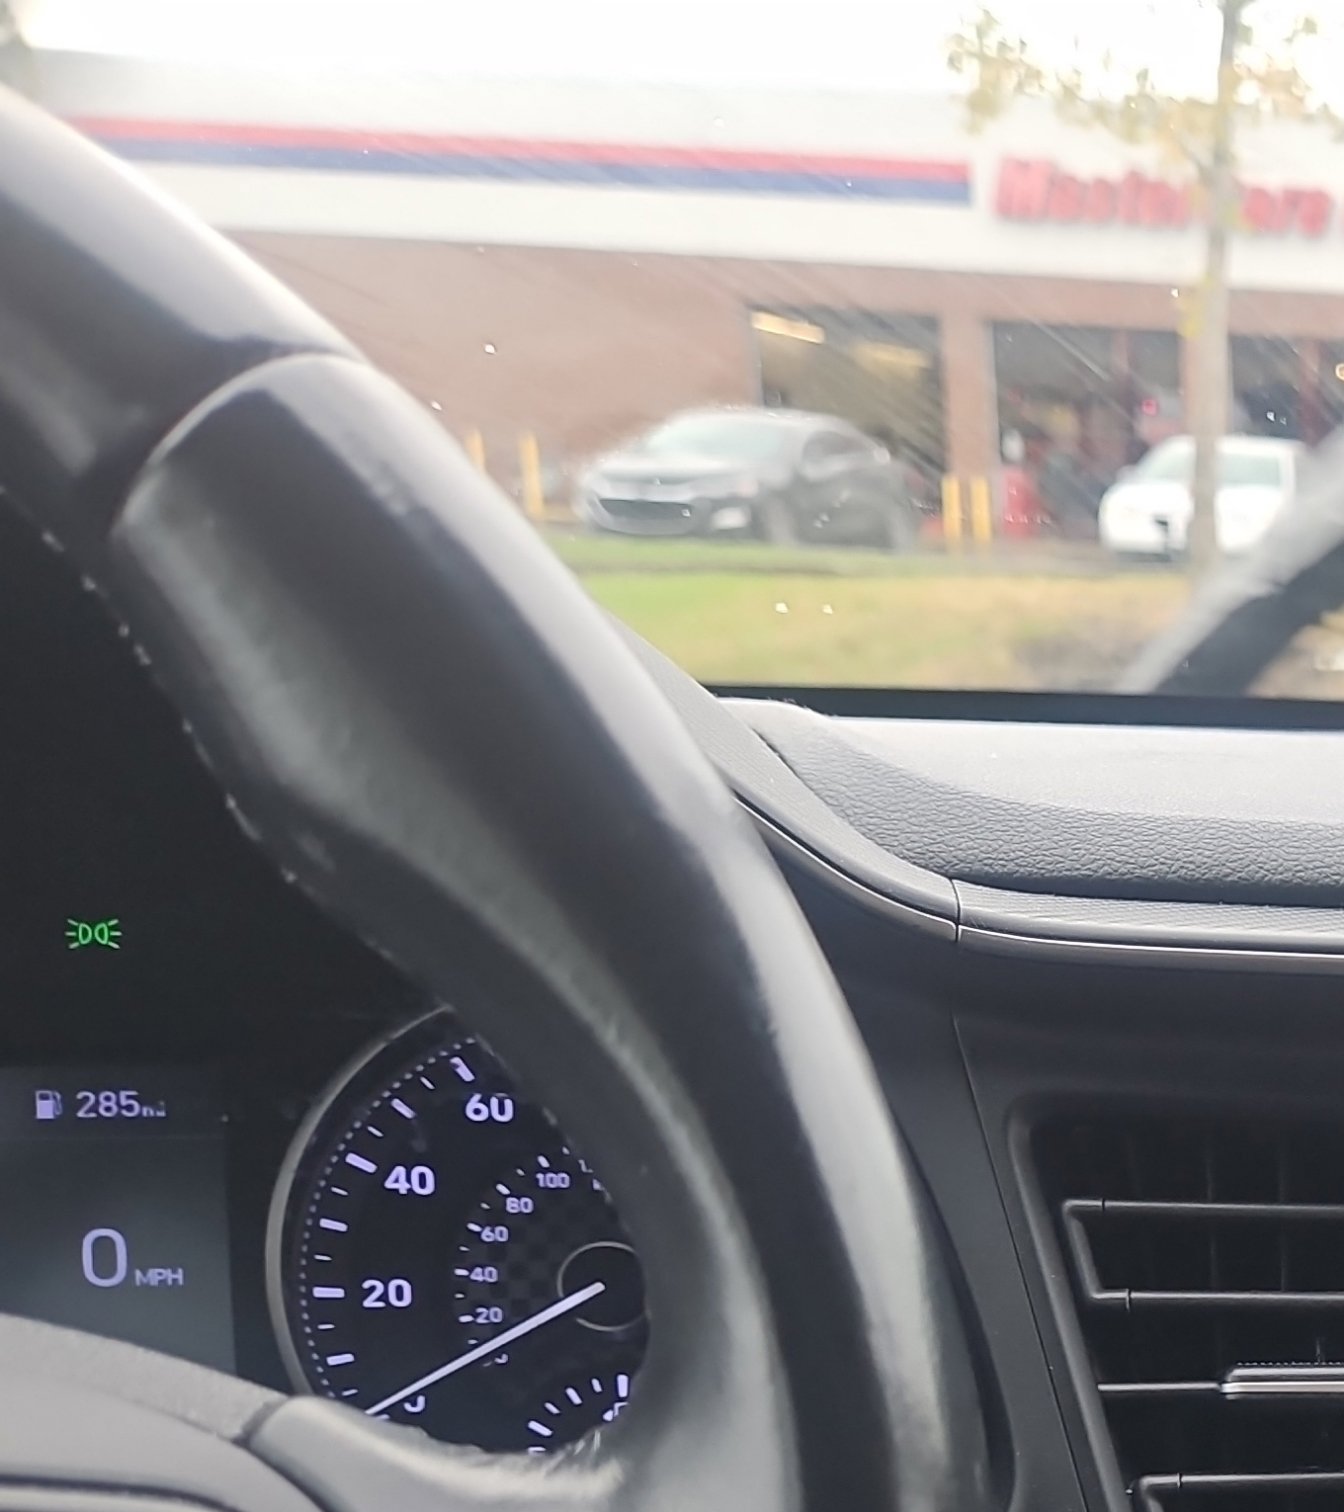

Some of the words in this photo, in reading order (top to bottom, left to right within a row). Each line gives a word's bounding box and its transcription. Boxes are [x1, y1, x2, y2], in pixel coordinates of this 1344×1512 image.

[76, 1090, 141, 1118] 285
[384, 1165, 435, 1196] 40
[535, 1172, 570, 1189] 100
[505, 1196, 534, 1214] 80
[479, 1224, 511, 1244] 60
[134, 1267, 184, 1286] MPH
[468, 1264, 500, 1285] 40
[361, 1278, 412, 1308] 20
[473, 1305, 505, 1325] 20
